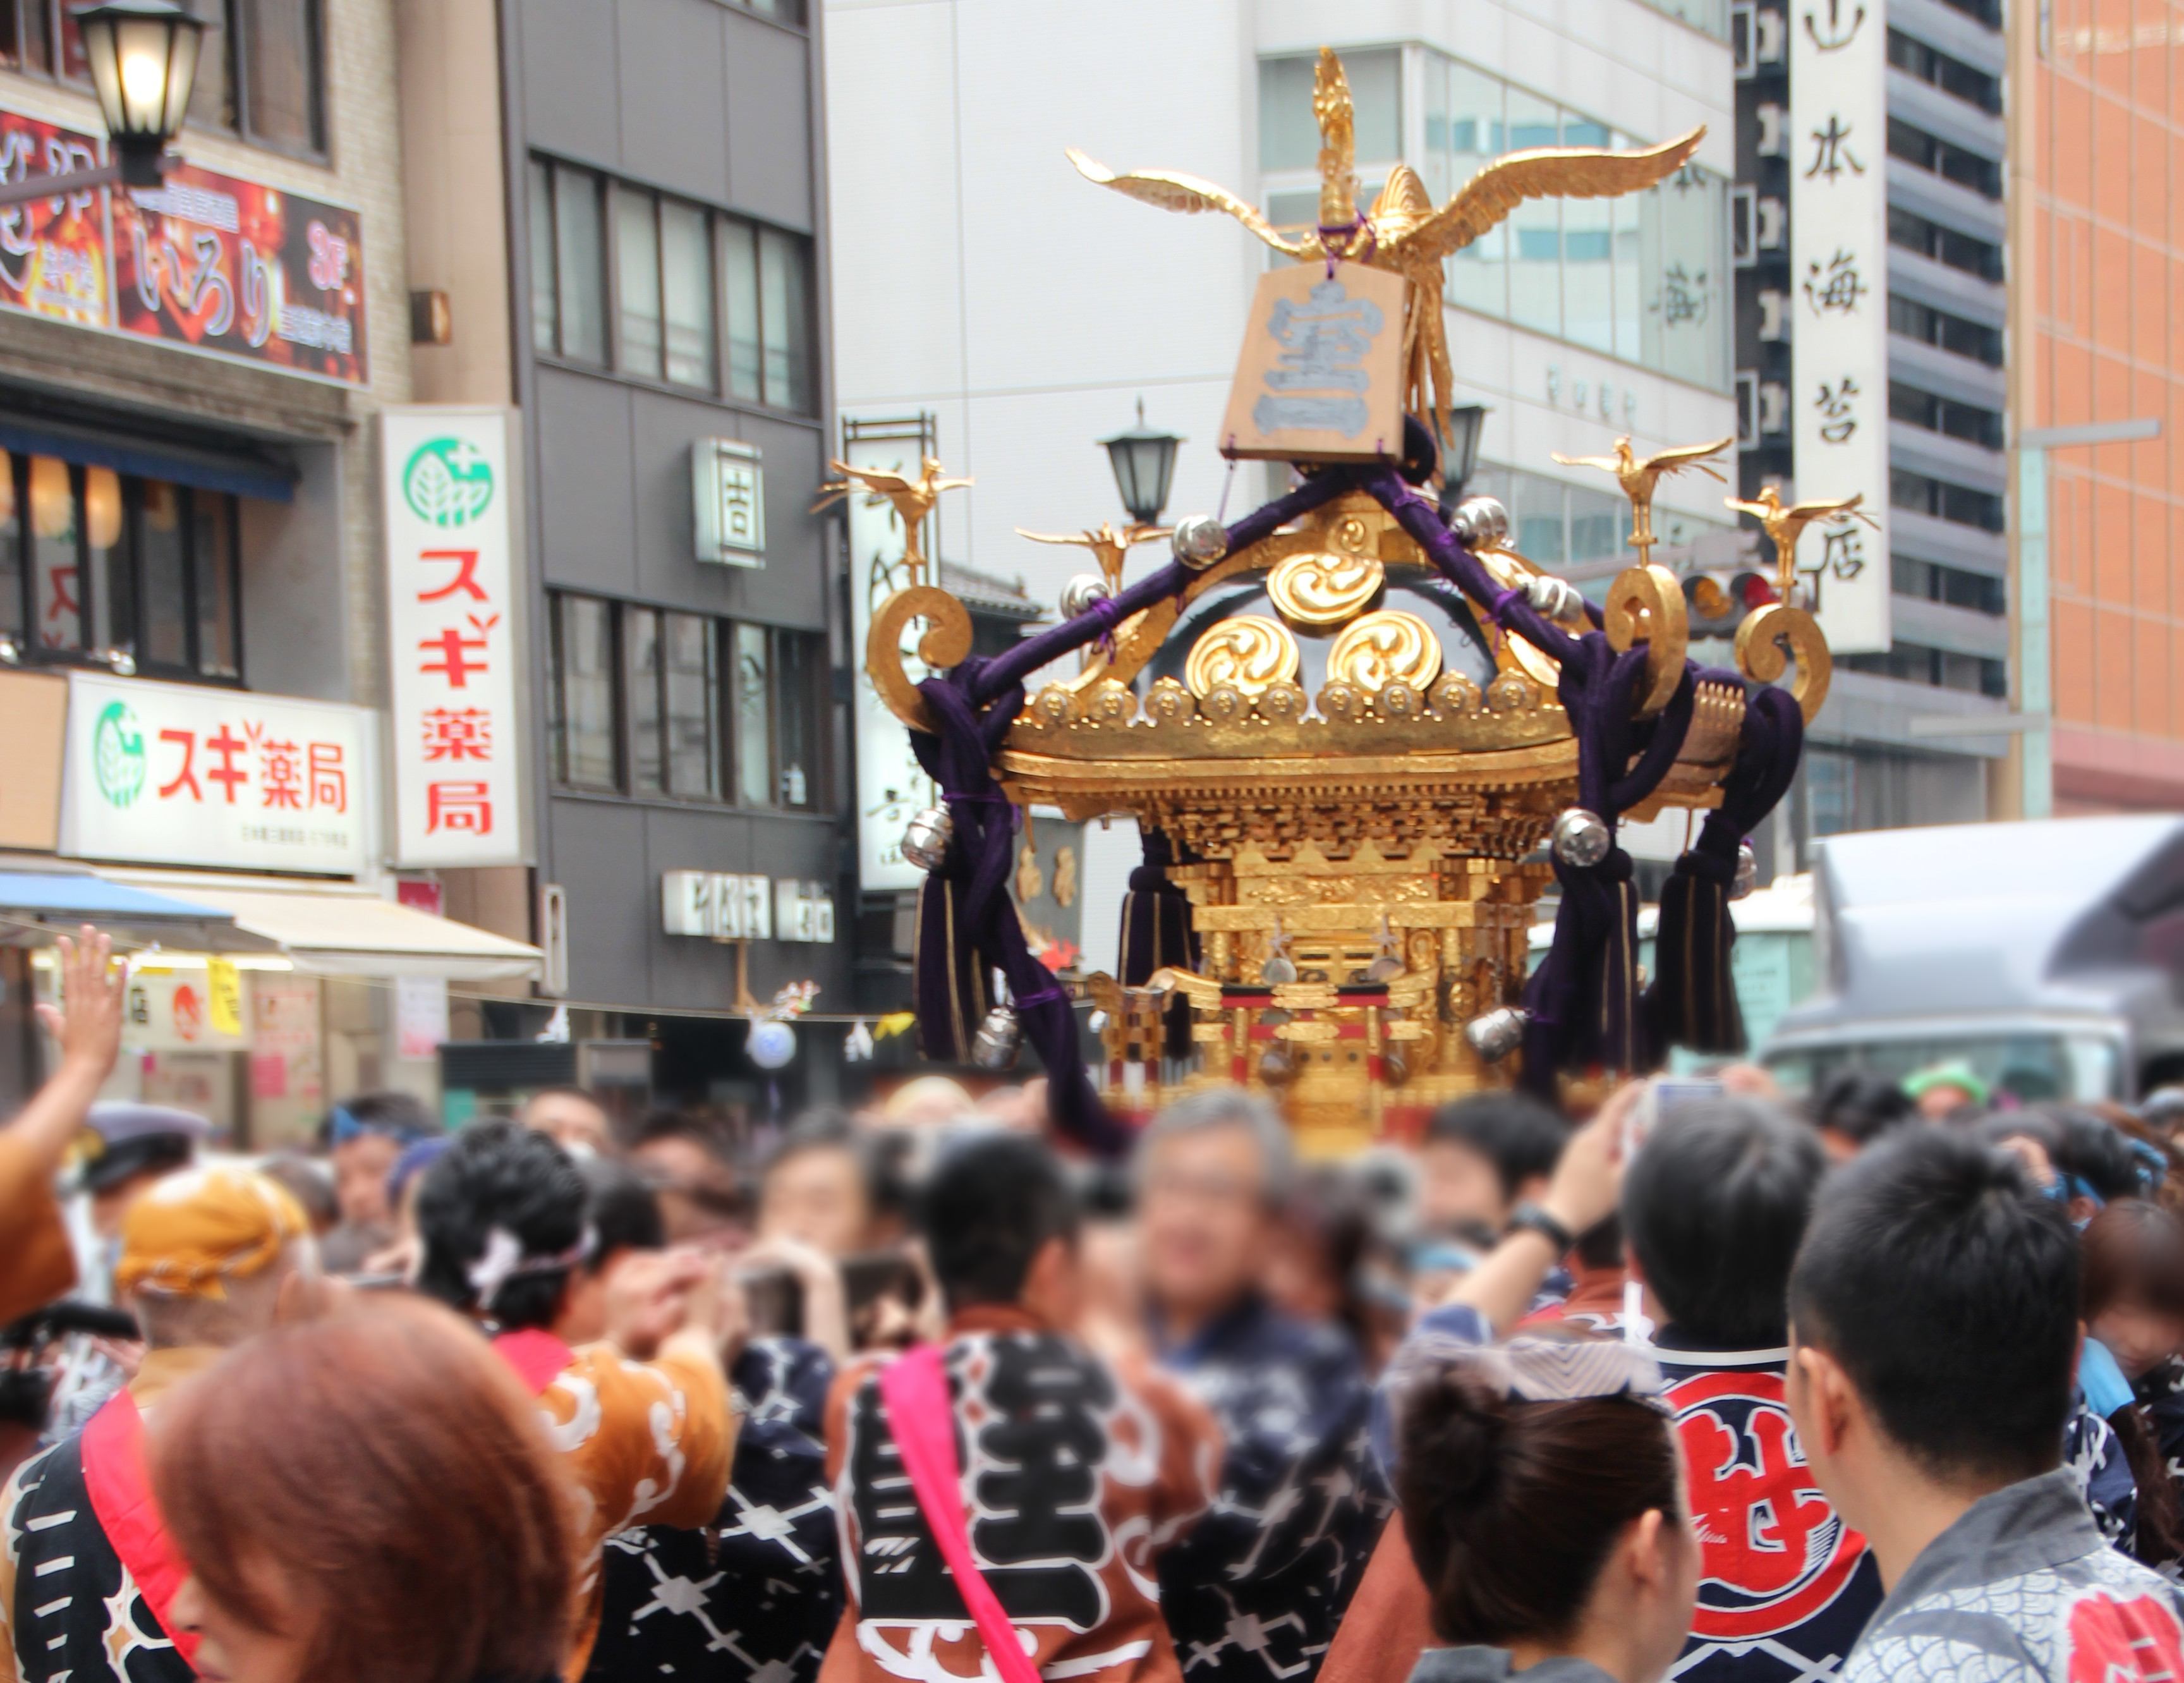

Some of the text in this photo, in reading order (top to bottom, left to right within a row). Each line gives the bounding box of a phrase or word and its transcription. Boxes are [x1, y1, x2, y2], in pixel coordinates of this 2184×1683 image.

[159, 719, 347, 815] スギ薬局
[417, 548, 500, 837] スギ薬局
